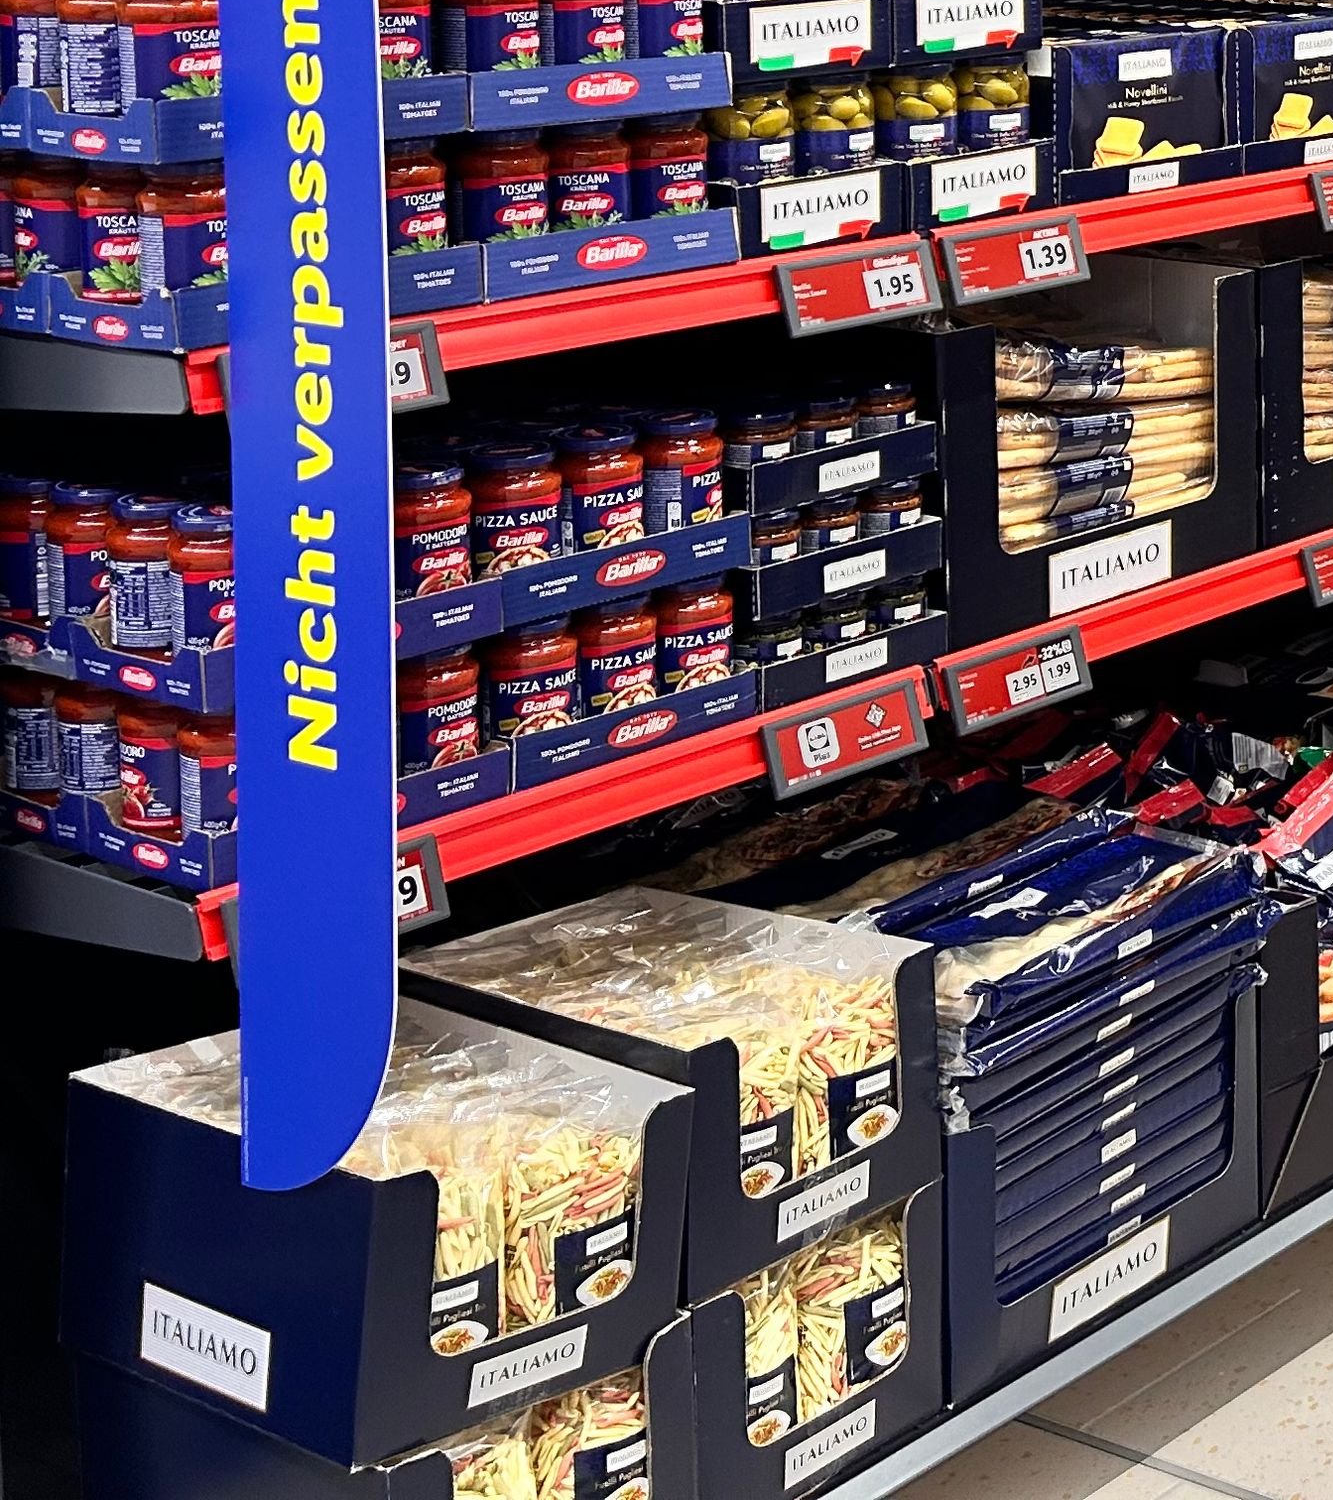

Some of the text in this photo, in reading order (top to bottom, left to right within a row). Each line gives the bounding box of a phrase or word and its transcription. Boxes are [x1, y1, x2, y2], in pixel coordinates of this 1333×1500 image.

[926, 0, 1014, 25] ITALIAMO
[762, 15, 860, 42] ITALIAMO
[575, 75, 637, 98] Barilla
[1125, 84, 1168, 99] Novellini
[558, 172, 610, 186] TOSCANA
[561, 193, 612, 212] Barilla
[773, 188, 869, 220] ITALIAMO
[584, 243, 645, 267] Barilla
[1025, 242, 1068, 269] 1.39
[873, 273, 915, 298] 1.95
[824, 460, 875, 482] ITALIAMO
[475, 505, 558, 528] PIZZA SAUCE
[412, 523, 468, 545] POMODORO
[495, 529, 544, 548] Barilla
[604, 554, 662, 584] Barilla
[1060, 542, 1162, 591] ITALIAMO
[284, 505, 338, 771] Nicht
[664, 624, 734, 649] PIZZA SAUCE
[1012, 672, 1039, 694] 2.95
[1047, 661, 1072, 683] 1.99
[784, 1175, 863, 1227] ITALIAMO
[1061, 1240, 1161, 1317] ITALIAMO
[152, 1310, 260, 1377] ITALIAMO
[478, 1339, 577, 1390] ITALIAMO
